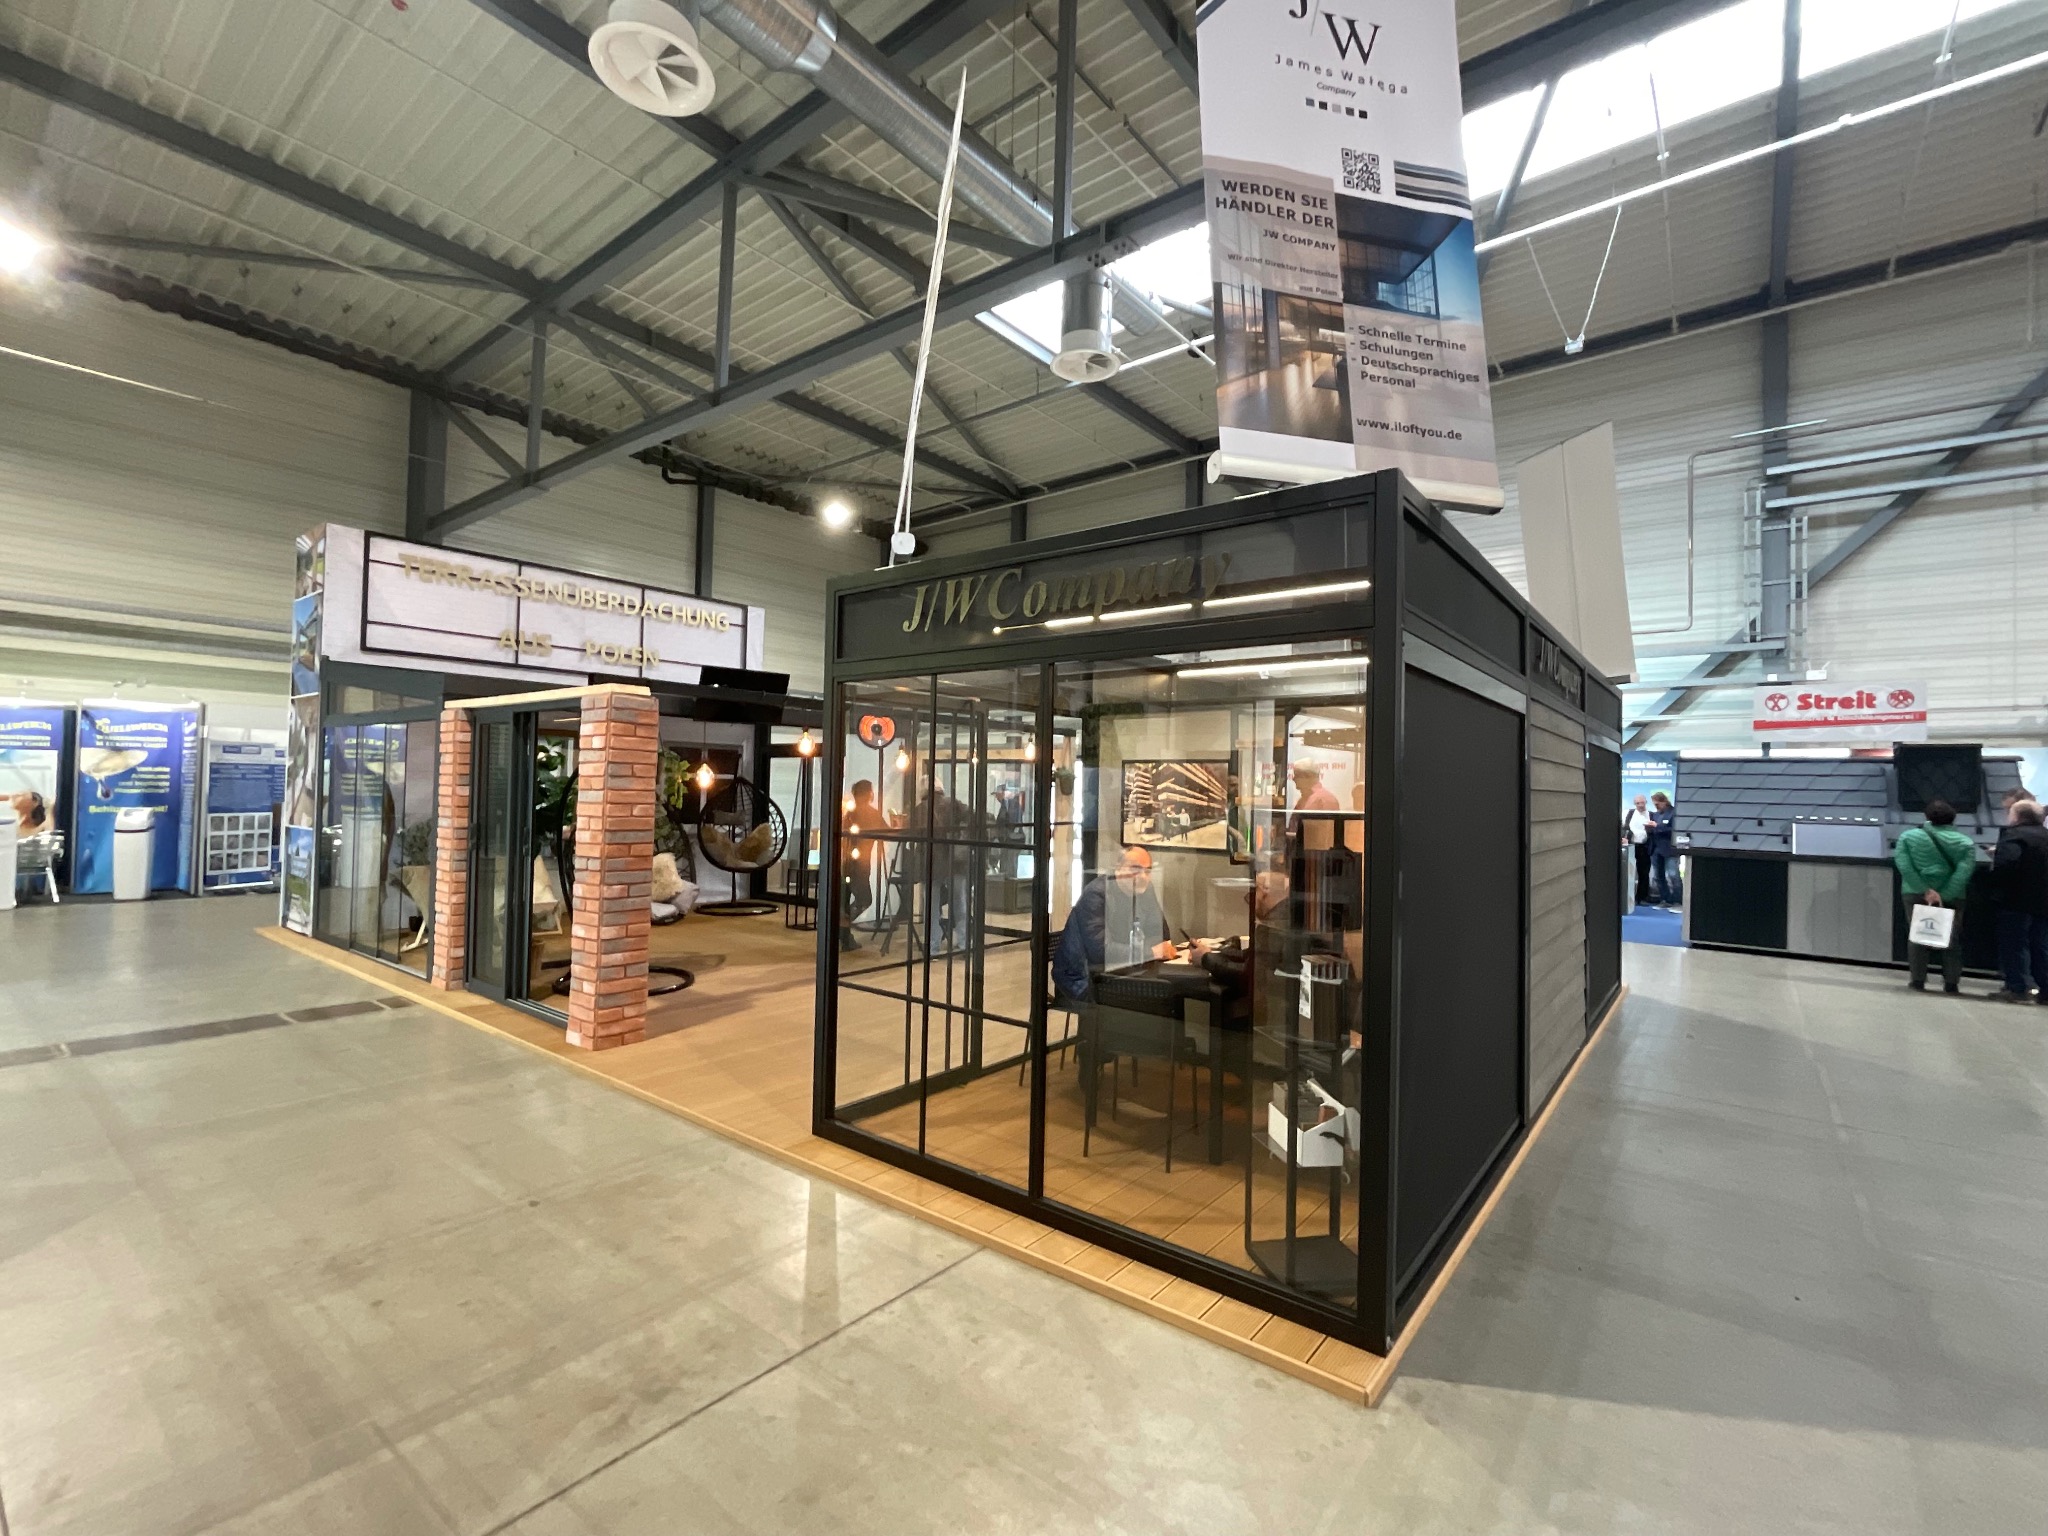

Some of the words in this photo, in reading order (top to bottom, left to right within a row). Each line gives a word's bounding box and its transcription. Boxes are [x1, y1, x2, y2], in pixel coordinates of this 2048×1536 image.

[1275, 54, 1333, 77] James
[1316, 81, 1357, 99] Company
[1222, 179, 1296, 203] WERDEN
[1301, 194, 1329, 210] SIE
[1215, 195, 1297, 221] HÄNDLER
[1302, 212, 1335, 229] DER
[1263, 229, 1279, 239] JW
[1282, 233, 1337, 252] COMPANY
[1358, 325, 1412, 343] Schnelle
[1415, 334, 1466, 352] Termine
[1360, 340, 1434, 361] Schulungen
[1361, 356, 1480, 383] Deutschsprachiges
[1361, 371, 1416, 388] Personal
[1356, 418, 1462, 441] www.iloftyou.de
[499, 630, 552, 657] AUS
[584, 639, 660, 669] POLEN
[1797, 690, 1877, 711] Streit
